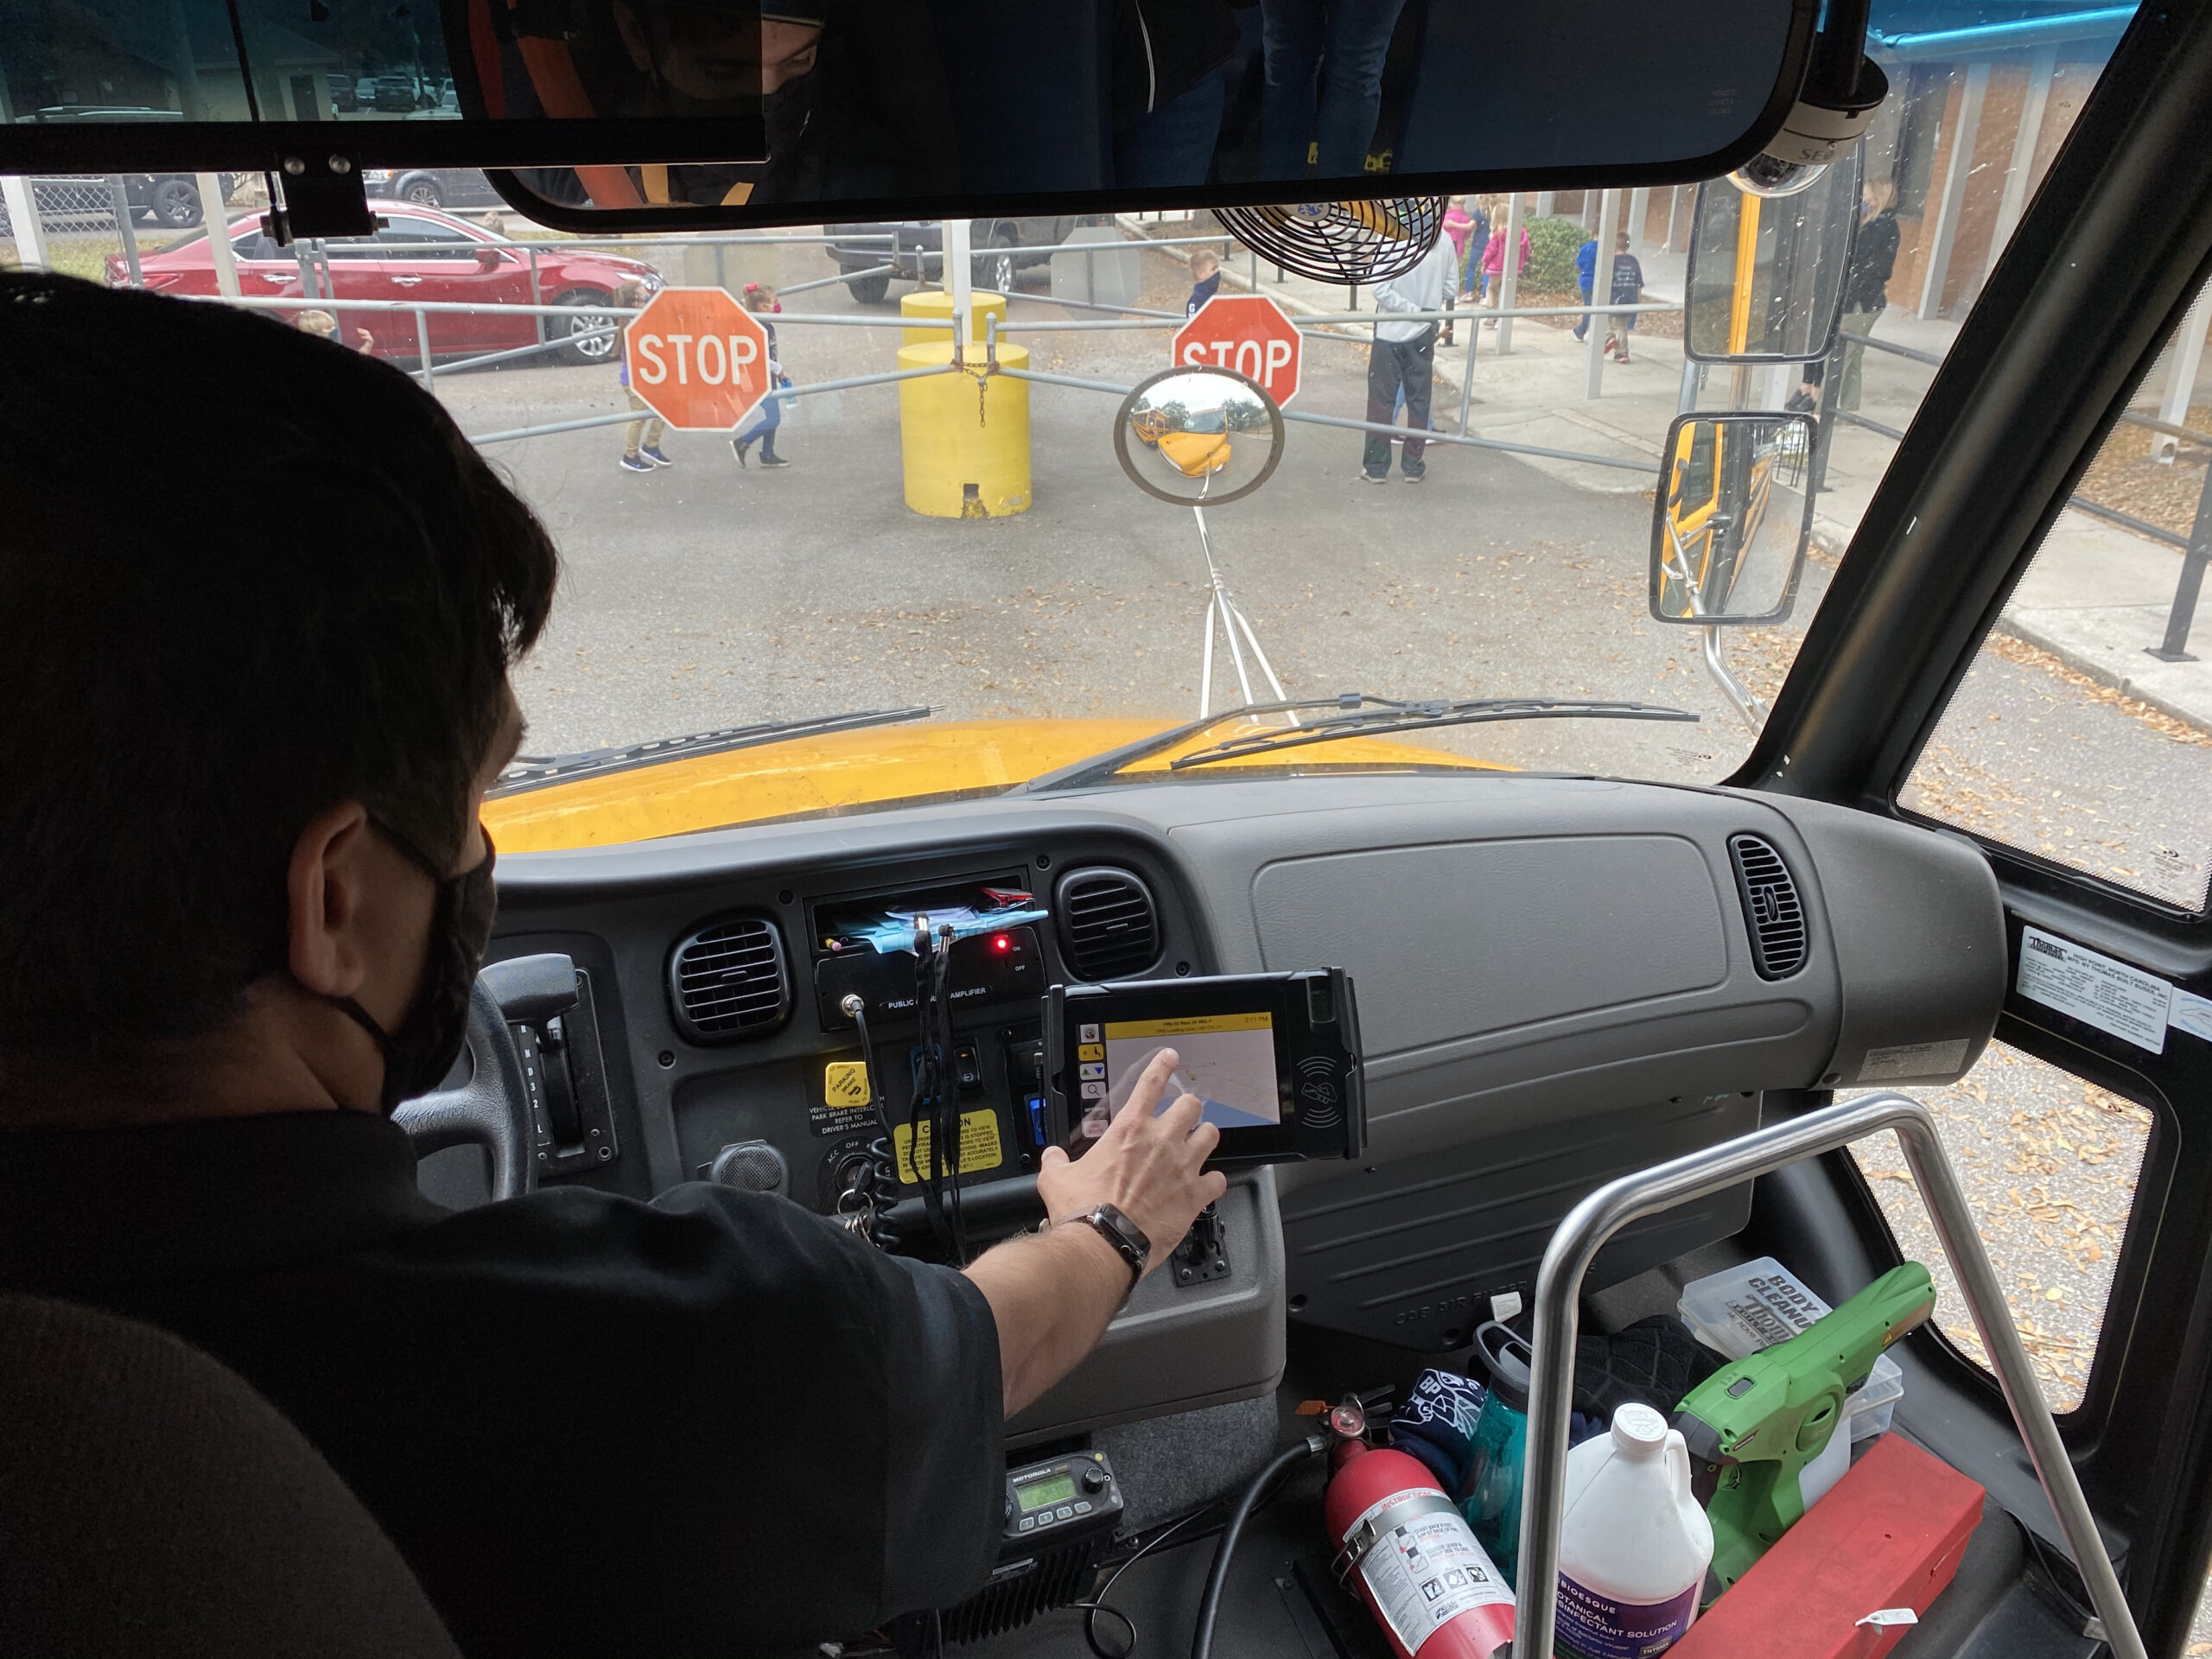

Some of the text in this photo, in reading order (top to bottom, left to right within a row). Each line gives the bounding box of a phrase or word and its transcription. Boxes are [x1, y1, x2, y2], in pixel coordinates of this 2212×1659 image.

[639, 334, 758, 385] STOP
[1183, 340, 1293, 388] STOP
[2028, 936, 2068, 957] Thomas
[2130, 974, 2161, 992] CAROLINA
[888, 999, 914, 1009] PUBLIC
[950, 987, 986, 999] AMPLIFIER
[524, 1049, 531, 1058] N
[527, 1067, 534, 1077] D
[832, 1068, 855, 1092] PARKING
[530, 1082, 537, 1091] 3
[842, 1077, 856, 1093] BRAKE
[532, 1099, 539, 1109] 2
[537, 1124, 543, 1134] L
[822, 1119, 878, 1135] DRIVER'S MANUAL
[835, 1116, 853, 1124] REFER
[828, 1149, 840, 1163] ACC
[1748, 1277, 1813, 1328] CLEANU
[1768, 1274, 1819, 1313] BODY
[1744, 1294, 1797, 1340] Thom
[1013, 1468, 1052, 1483] MOTOROLA
[1560, 1580, 1616, 1614] BIOESQUE
[1557, 1592, 1608, 1625] OTANICAL
[1556, 1599, 1624, 1637] SINFECTANT
[1627, 1620, 1677, 1639] SOLUTION
